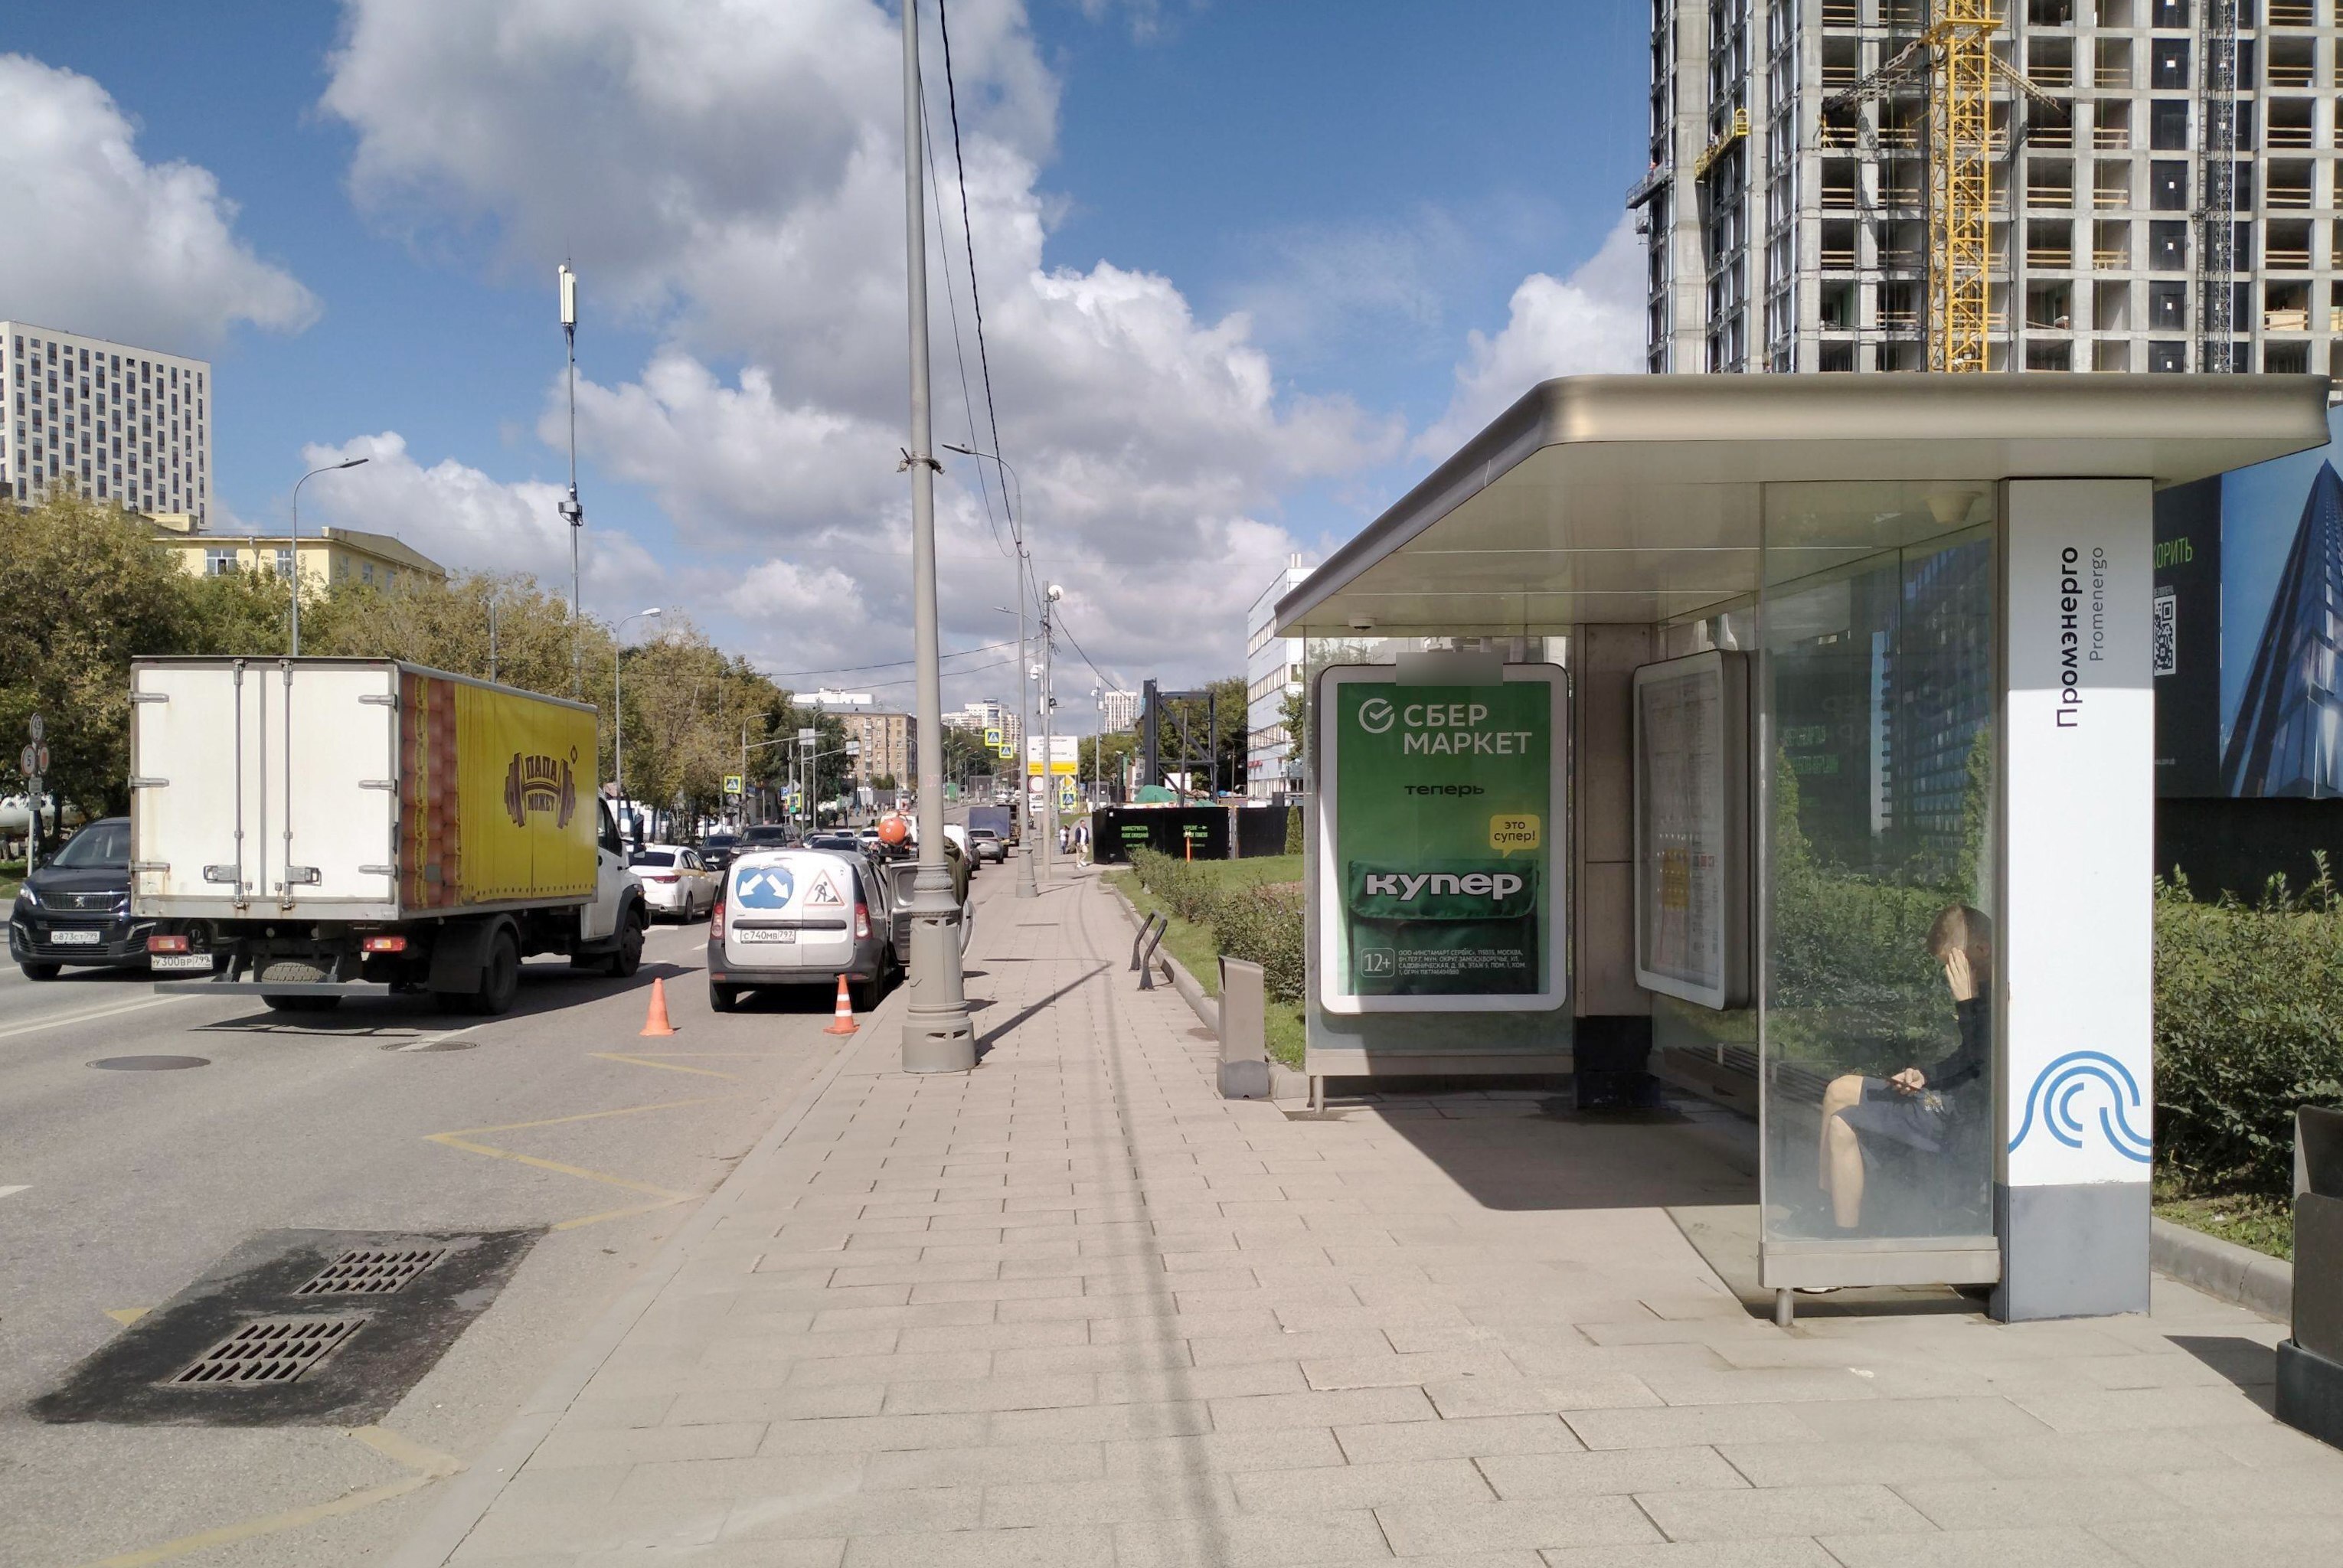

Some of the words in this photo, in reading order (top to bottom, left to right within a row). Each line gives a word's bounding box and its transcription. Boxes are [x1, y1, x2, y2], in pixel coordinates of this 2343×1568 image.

[2089, 547, 2107, 662] Promenergo
[2056, 547, 2083, 728] Промэнерго
[1404, 704, 1488, 727] СБЕР
[1404, 731, 1532, 755] МАРКЕТ
[525, 755, 557, 782] ПАПА
[528, 792, 555, 812] МОЖЕТ
[1404, 785, 1485, 798] теперь
[1494, 830, 1535, 843] супер!
[1504, 820, 1525, 830] это
[1366, 873, 1523, 902] купер
[1363, 952, 1391, 972] 12+
